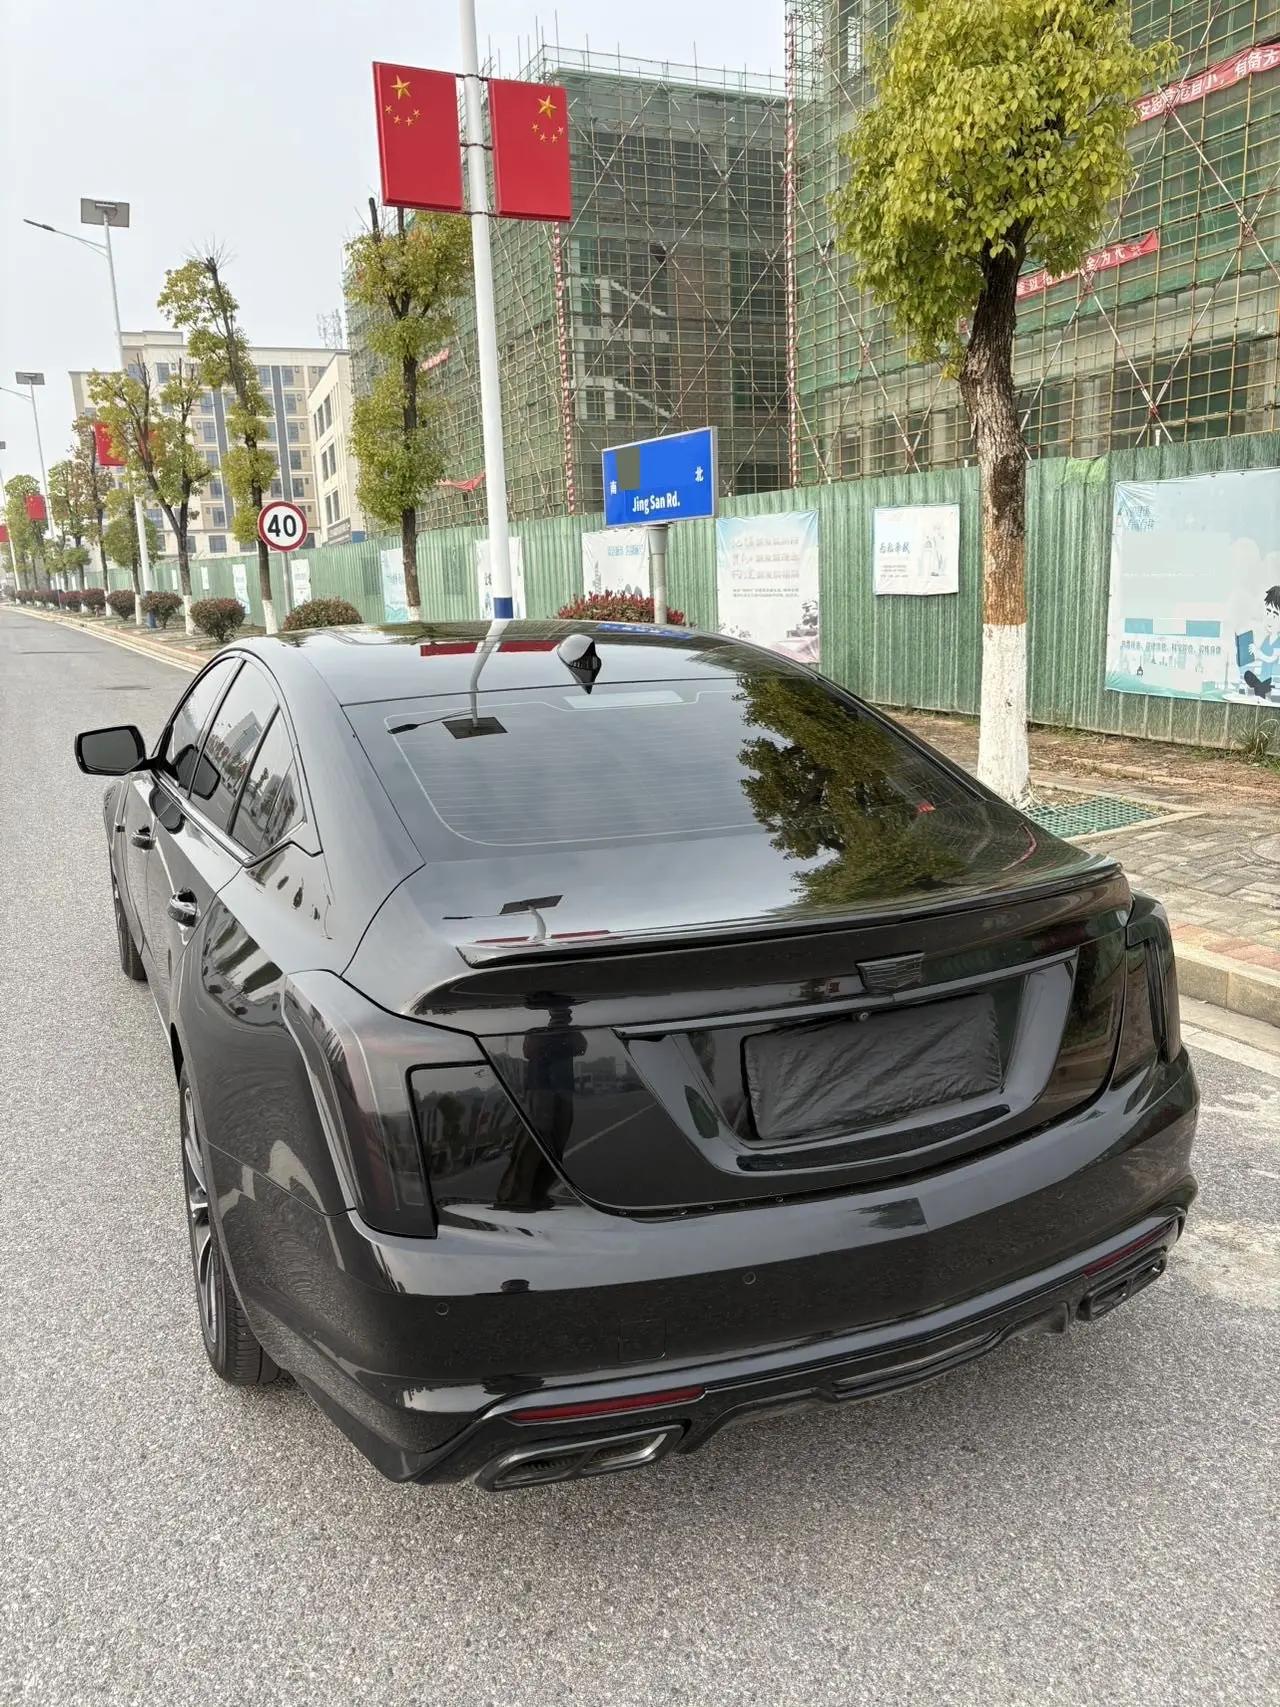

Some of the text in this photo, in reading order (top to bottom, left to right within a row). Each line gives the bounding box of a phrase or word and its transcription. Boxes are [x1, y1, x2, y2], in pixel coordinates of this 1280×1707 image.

[695, 466, 704, 482] 北
[610, 480, 617, 496] 南
[632, 491, 681, 514] Jing San Rd.
[267, 514, 297, 537] 40
